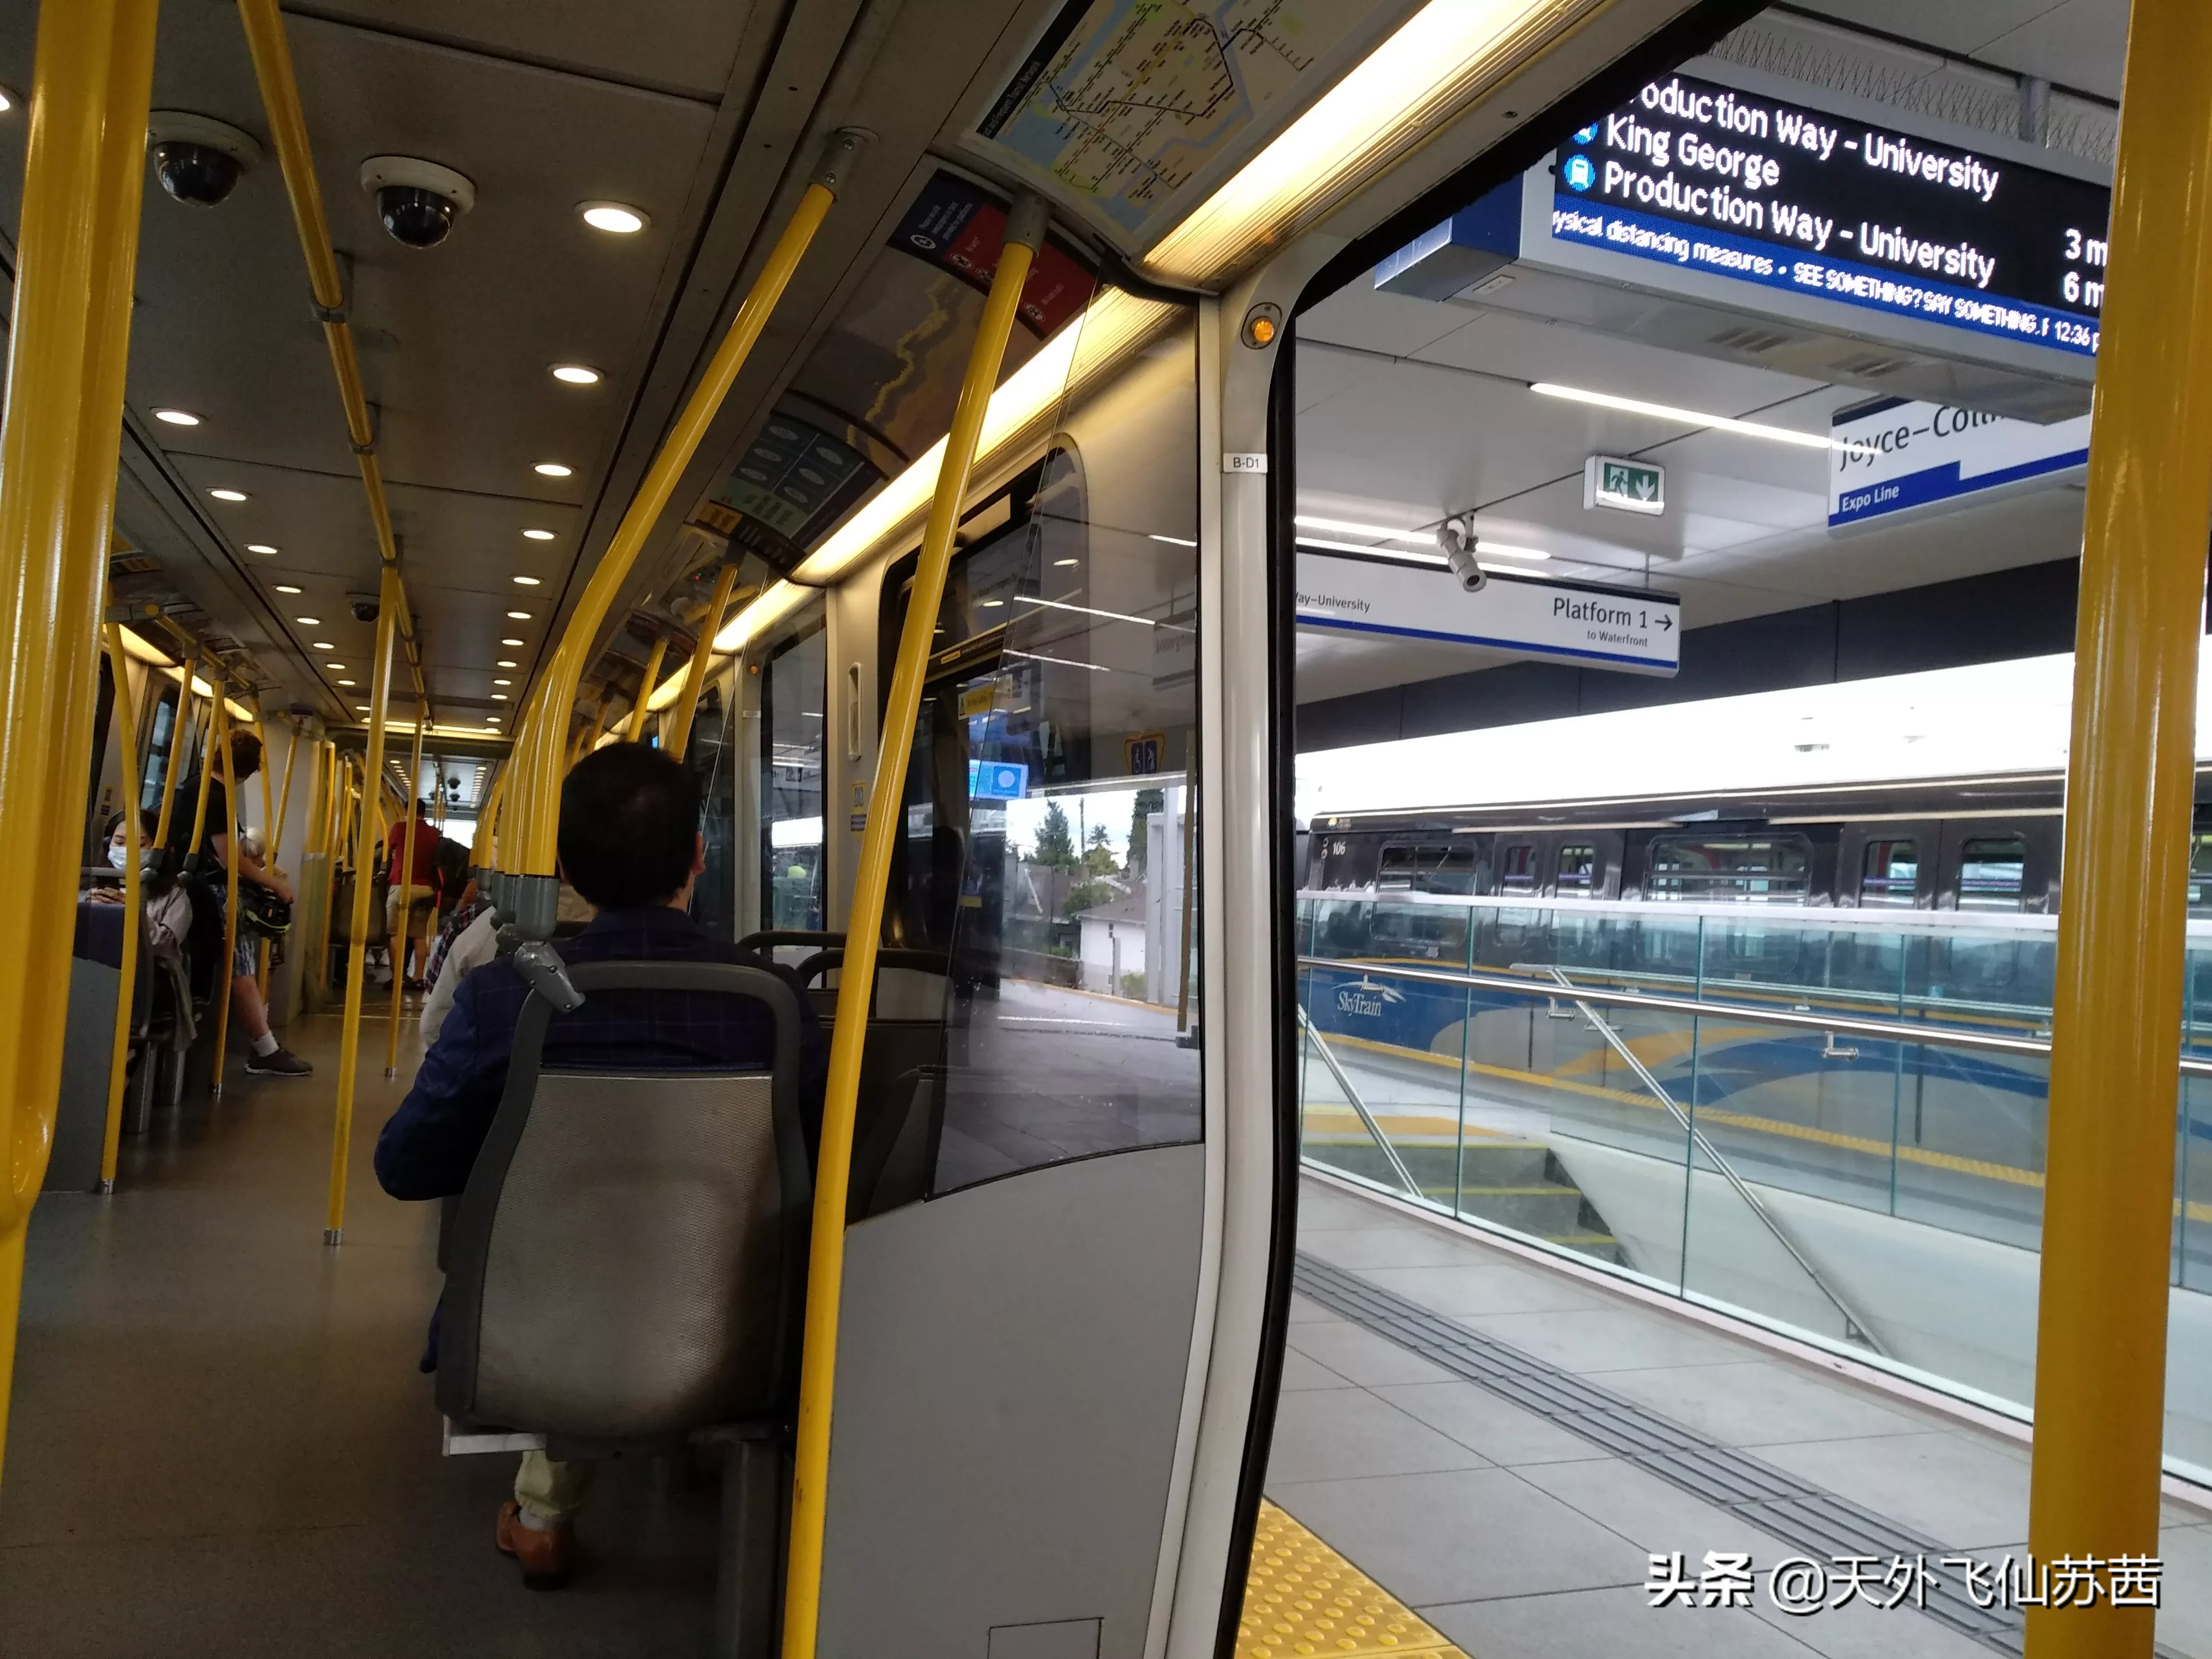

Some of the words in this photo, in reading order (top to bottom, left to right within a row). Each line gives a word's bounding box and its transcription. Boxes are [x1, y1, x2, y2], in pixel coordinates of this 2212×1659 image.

[1606, 112, 1671, 167] King
[1678, 132, 1780, 190] George
[1630, 78, 1768, 138] oduction
[1776, 109, 1838, 161] Way
[1864, 133, 2000, 202] University
[1604, 160, 1764, 226] Production
[1771, 200, 1833, 251] Way
[1860, 221, 1996, 289] University
[2065, 228, 2081, 260] 3
[1606, 219, 1690, 262] distancing
[1692, 241, 1773, 275] measures
[1793, 262, 1824, 288] SEE
[1923, 290, 1953, 316] SAY
[2054, 320, 2091, 347] 12:36
[2063, 270, 2080, 303] 6
[1233, 456, 1259, 469] B-D1
[1842, 492, 1871, 513] Expo
[1874, 484, 1900, 504] Line
[1553, 597, 1631, 627] Platform
[1639, 610, 1647, 629] 1
[1587, 629, 1597, 640] to
[1599, 630, 1648, 647] Waterfront
[1333, 841, 1346, 855] 106
[1337, 990, 1383, 1017] SkyTrain
